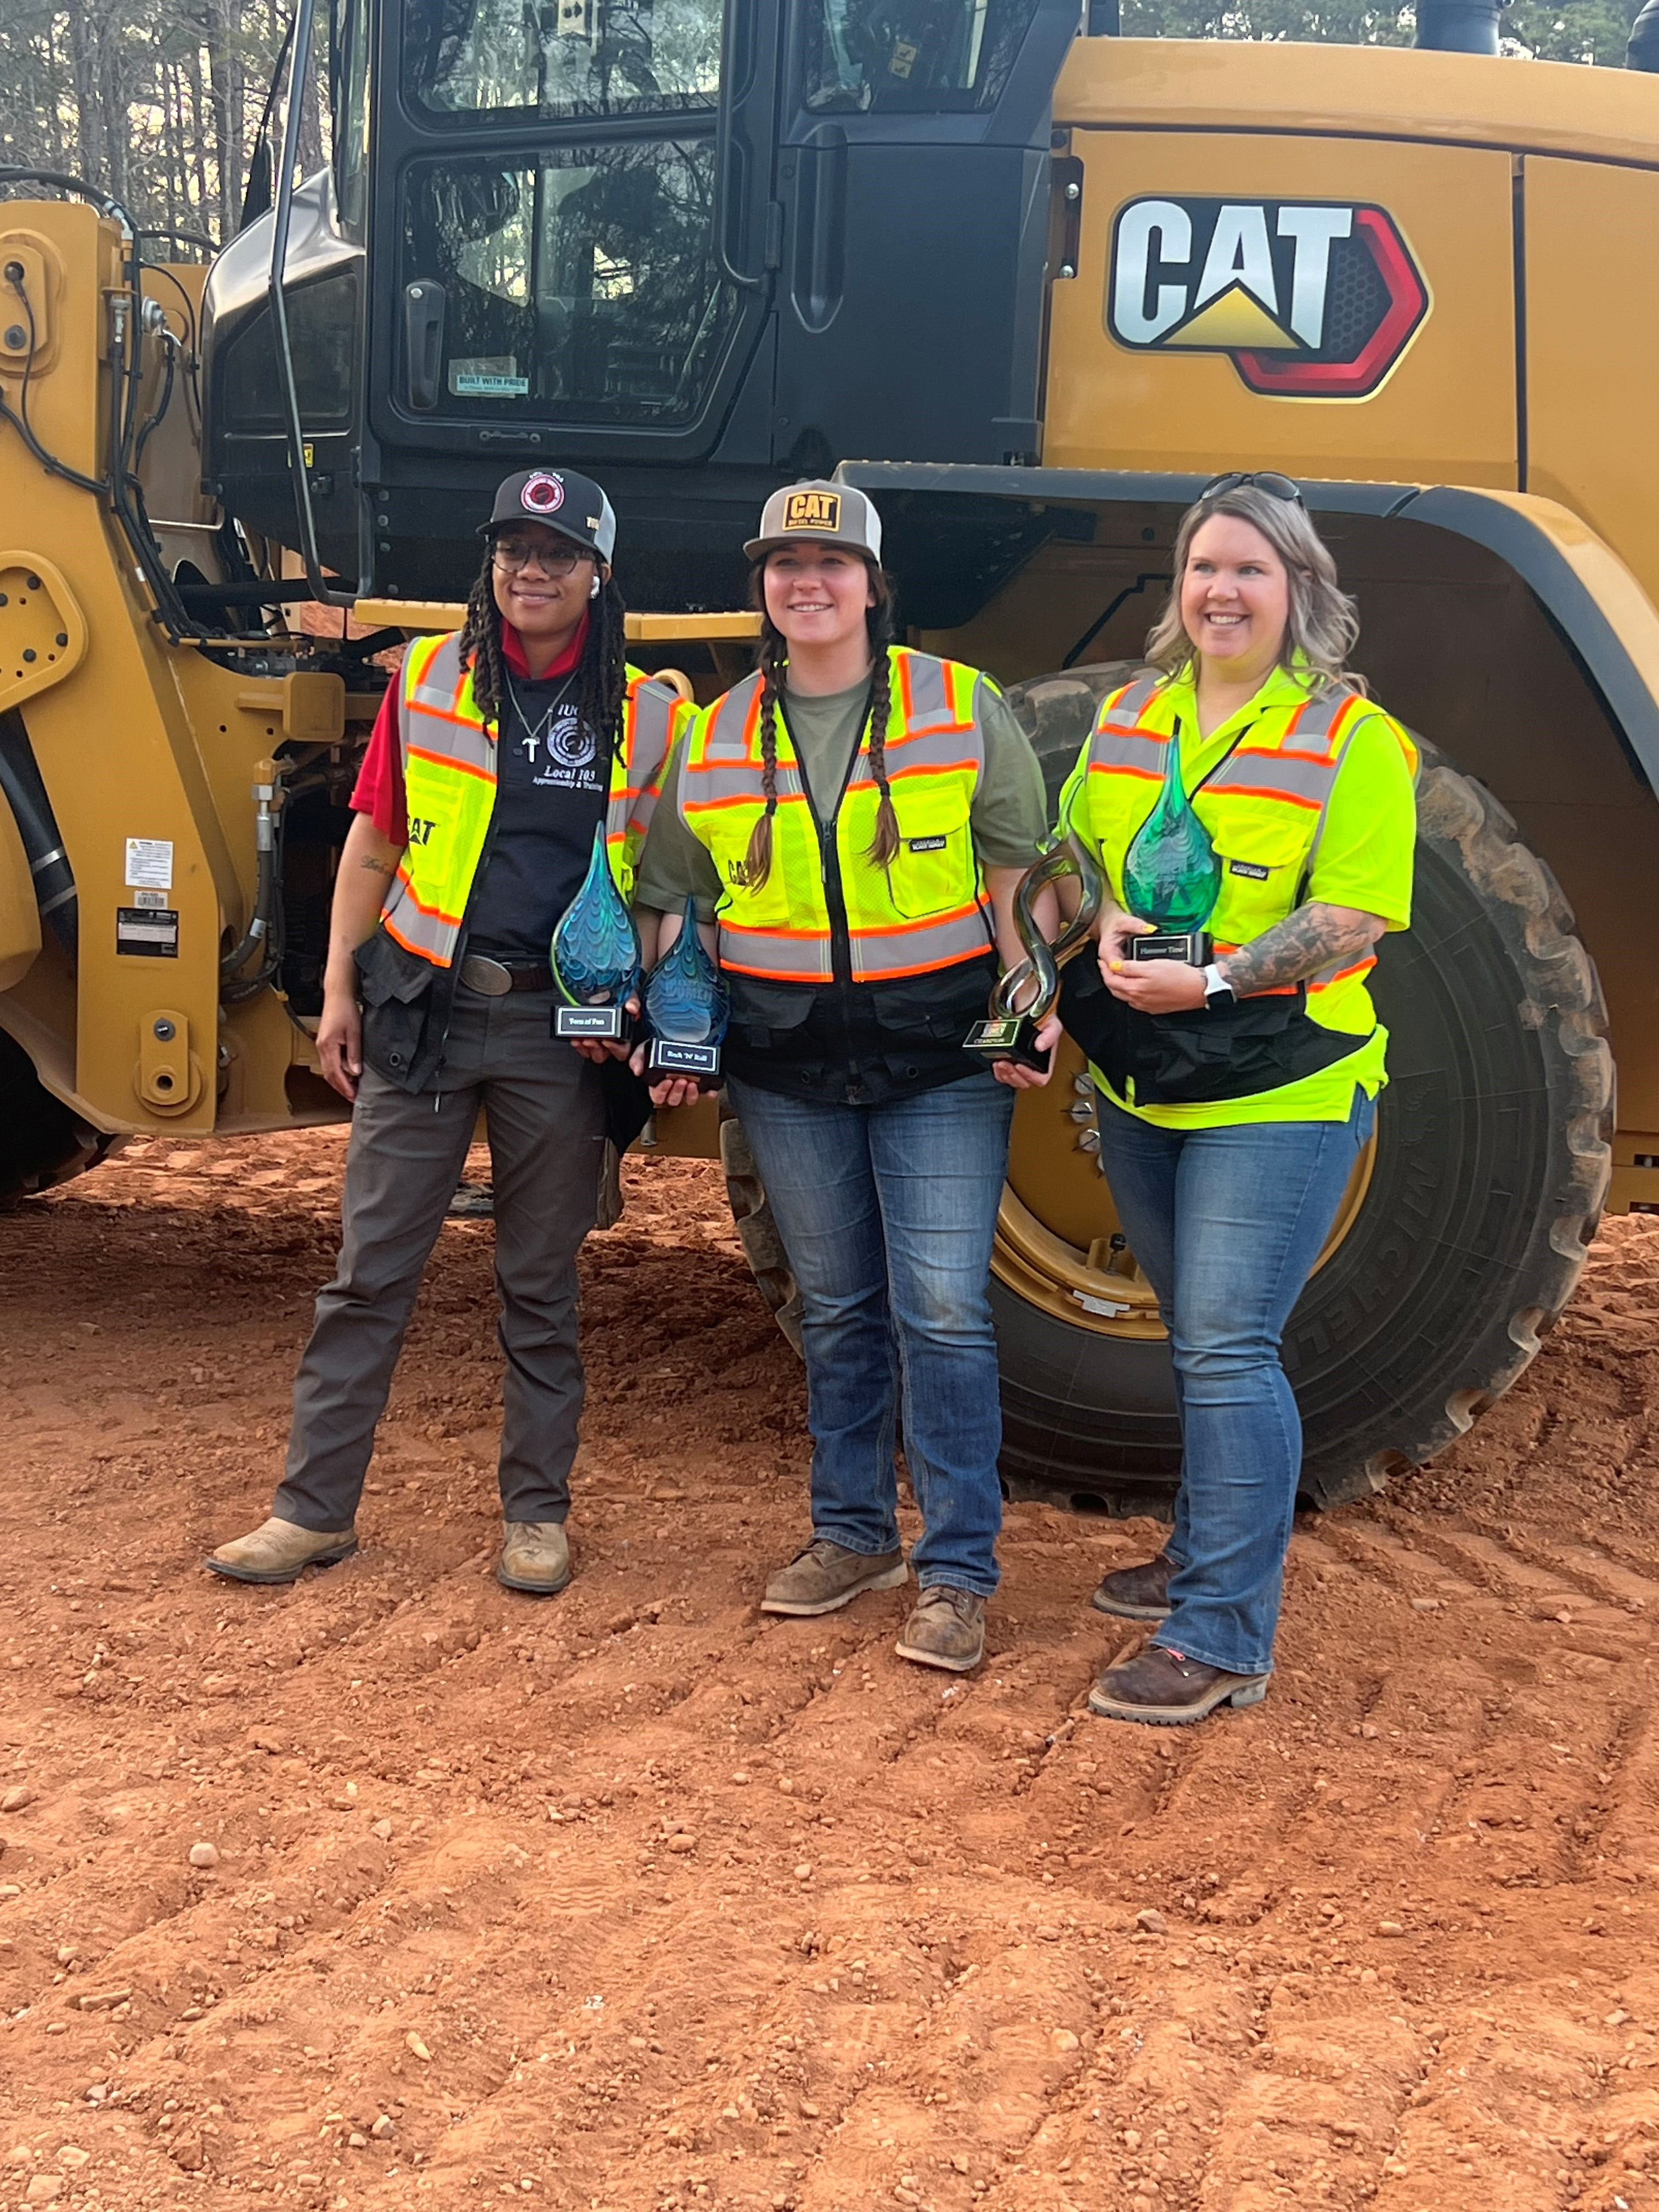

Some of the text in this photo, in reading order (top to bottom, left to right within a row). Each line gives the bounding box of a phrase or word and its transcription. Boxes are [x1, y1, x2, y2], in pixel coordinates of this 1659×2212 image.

[1114, 201, 1353, 349] CAT
[791, 495, 834, 519] CAT
[543, 765, 596, 782] Local 103
[1281, 1158, 1440, 1373] MICHELI
